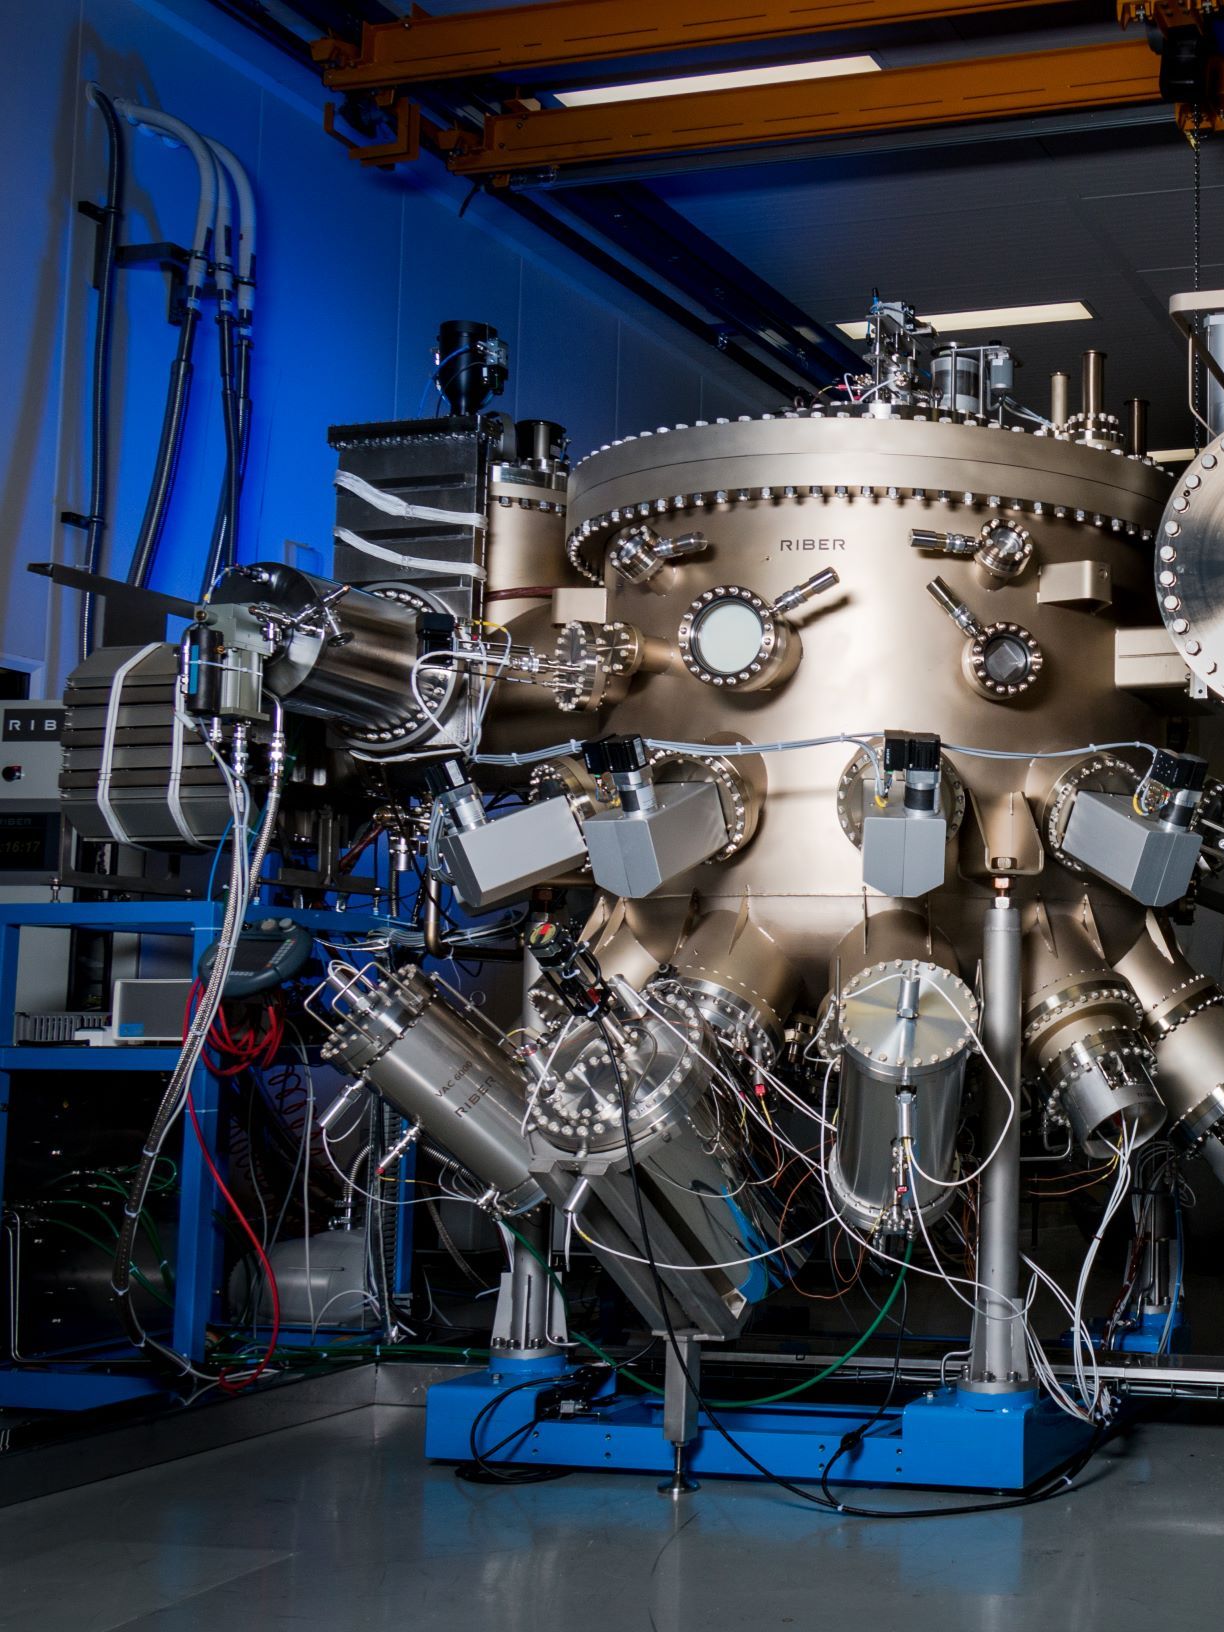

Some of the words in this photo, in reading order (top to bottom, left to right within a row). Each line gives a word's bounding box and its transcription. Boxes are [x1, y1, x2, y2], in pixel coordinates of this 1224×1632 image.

[780, 538, 845, 551] RIBER
[435, 1080, 455, 1097] VAC
[454, 1060, 473, 1081] 6000
[455, 1075, 496, 1118] RIBER
